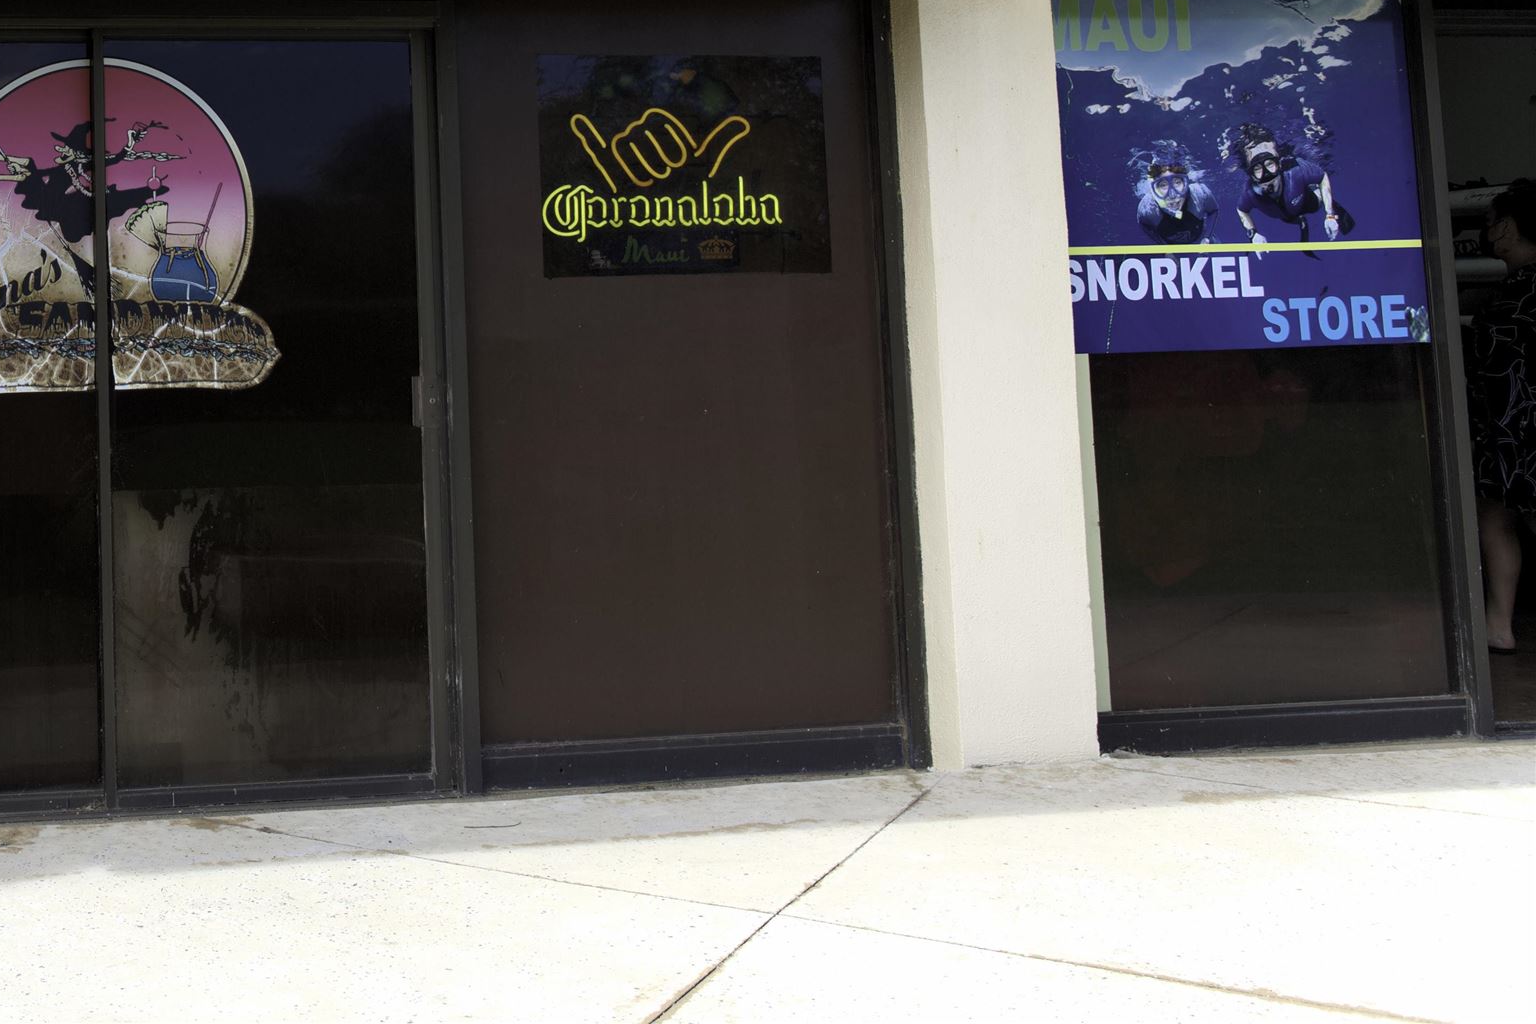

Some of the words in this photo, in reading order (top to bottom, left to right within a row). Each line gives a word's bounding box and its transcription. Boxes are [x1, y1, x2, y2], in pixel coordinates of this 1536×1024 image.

[542, 176, 784, 243] Coronaloha
[1068, 256, 1265, 303] SNORKEL
[1262, 294, 1409, 343] STORE
